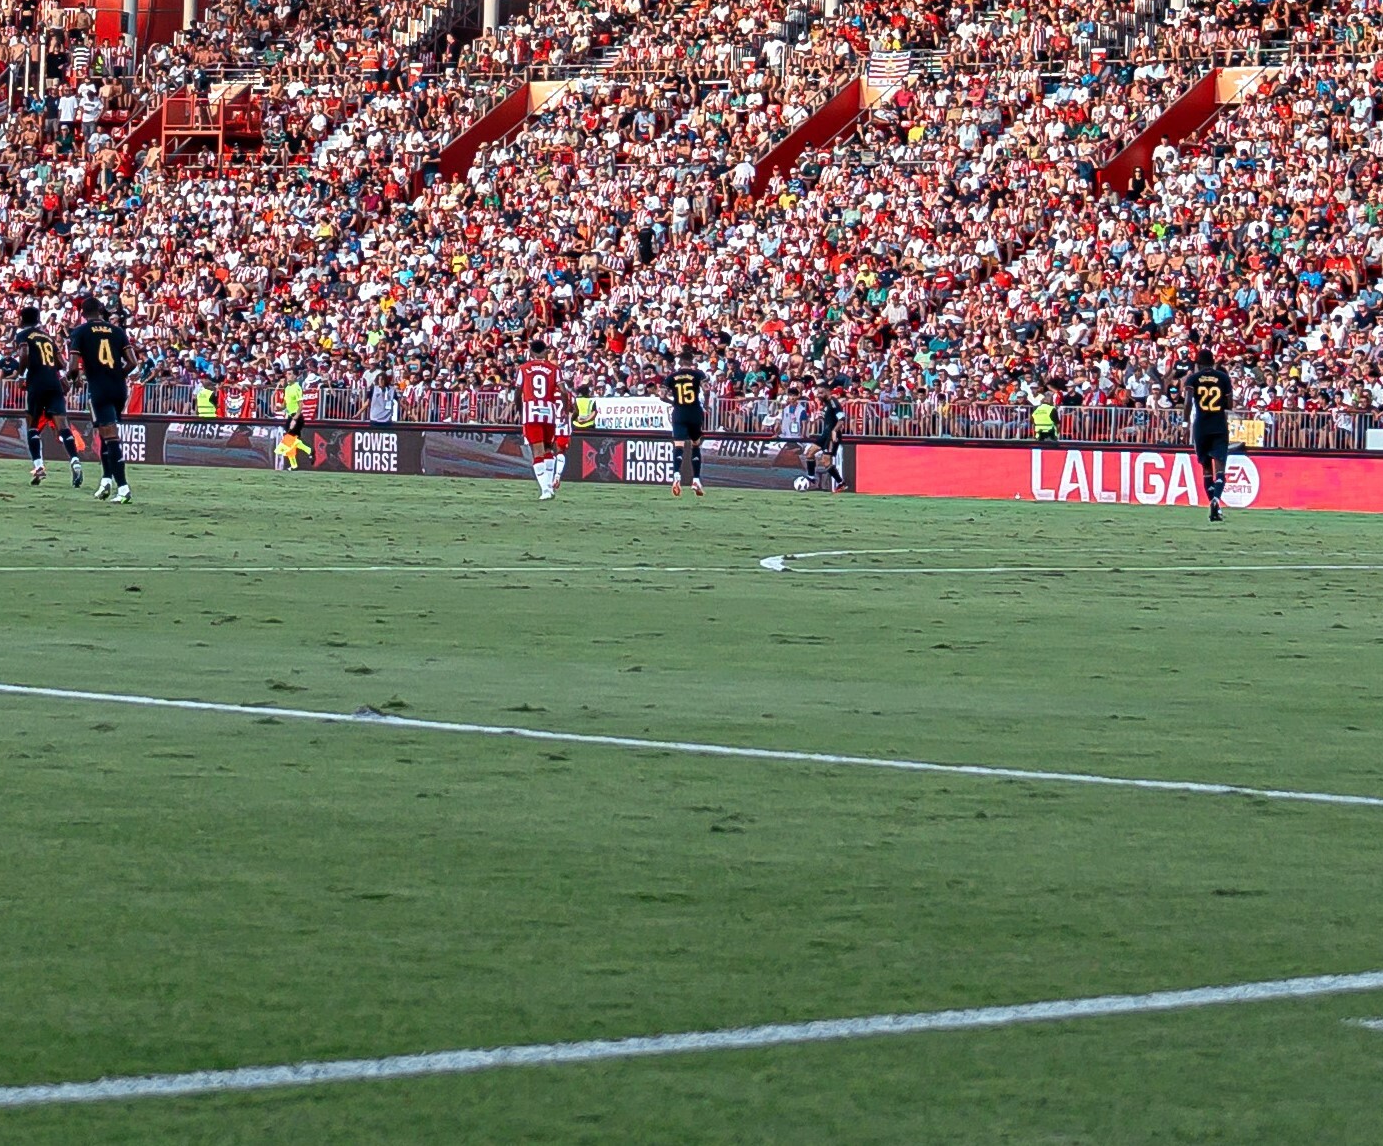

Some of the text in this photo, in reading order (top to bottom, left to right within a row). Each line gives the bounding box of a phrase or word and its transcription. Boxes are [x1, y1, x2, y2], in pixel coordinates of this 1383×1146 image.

[35, 341, 55, 367] 18
[98, 338, 115, 369] 4
[532, 374, 547, 399] 9
[675, 382, 696, 405] 15
[1197, 385, 1222, 412] 22
[606, 405, 663, 415] DEPORTIVA
[354, 432, 398, 452] POWER
[626, 440, 674, 461] POWER
[719, 441, 769, 458] HORSE
[354, 452, 398, 472] HORSE
[626, 461, 674, 482] HORSE
[1031, 448, 1199, 506] LALIGA
[1225, 466, 1251, 484] EA
